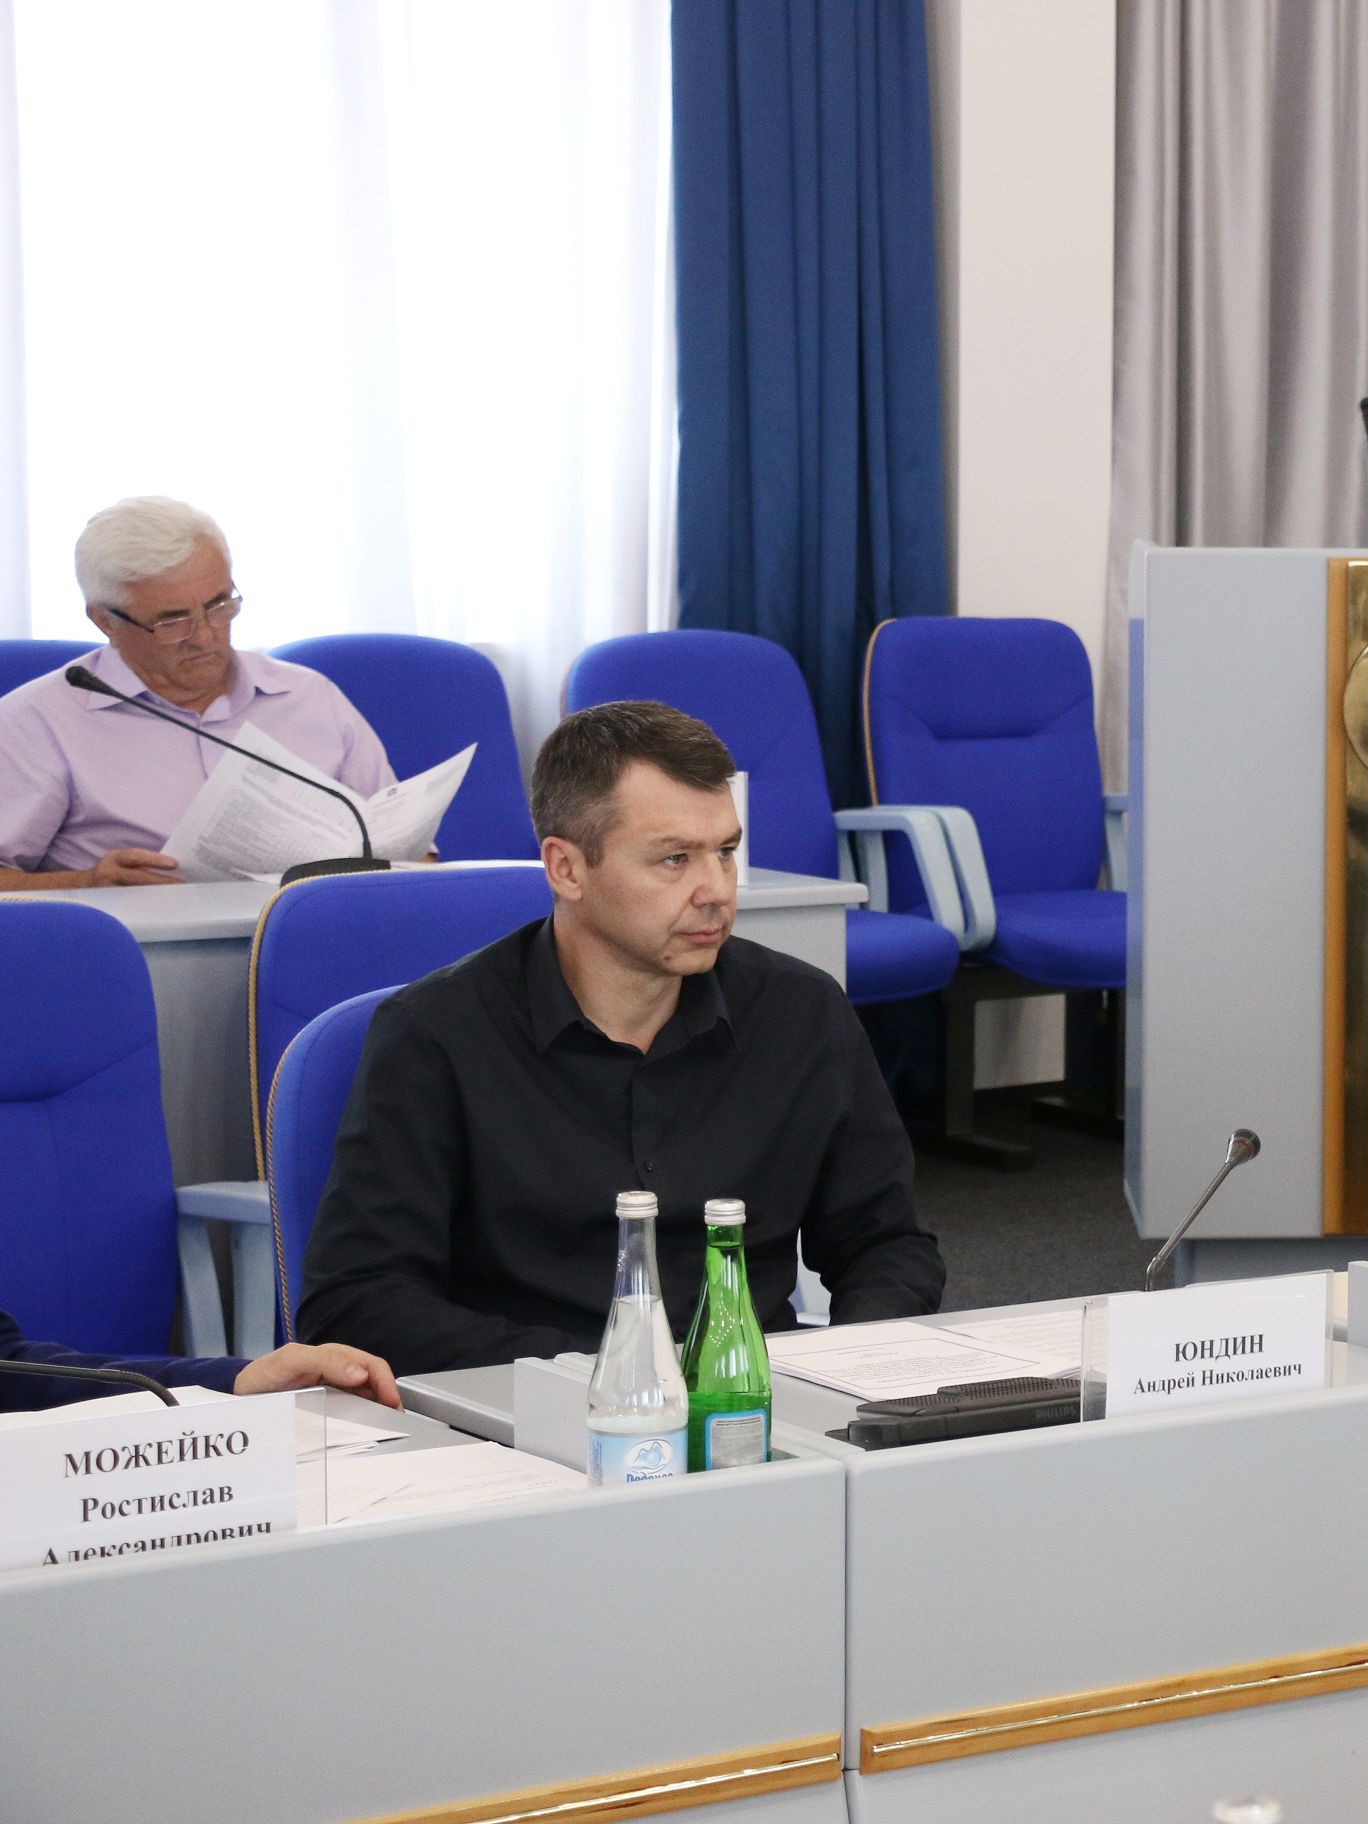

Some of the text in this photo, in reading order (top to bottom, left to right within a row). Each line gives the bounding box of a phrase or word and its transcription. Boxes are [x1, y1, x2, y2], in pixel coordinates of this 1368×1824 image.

[1174, 1333, 1265, 1362] ЮНДИН
[1133, 1363, 1302, 1395] Андрей Николаевич
[64, 1430, 250, 1478] МОЖЕЙКО
[80, 1485, 234, 1523] Ростислав
